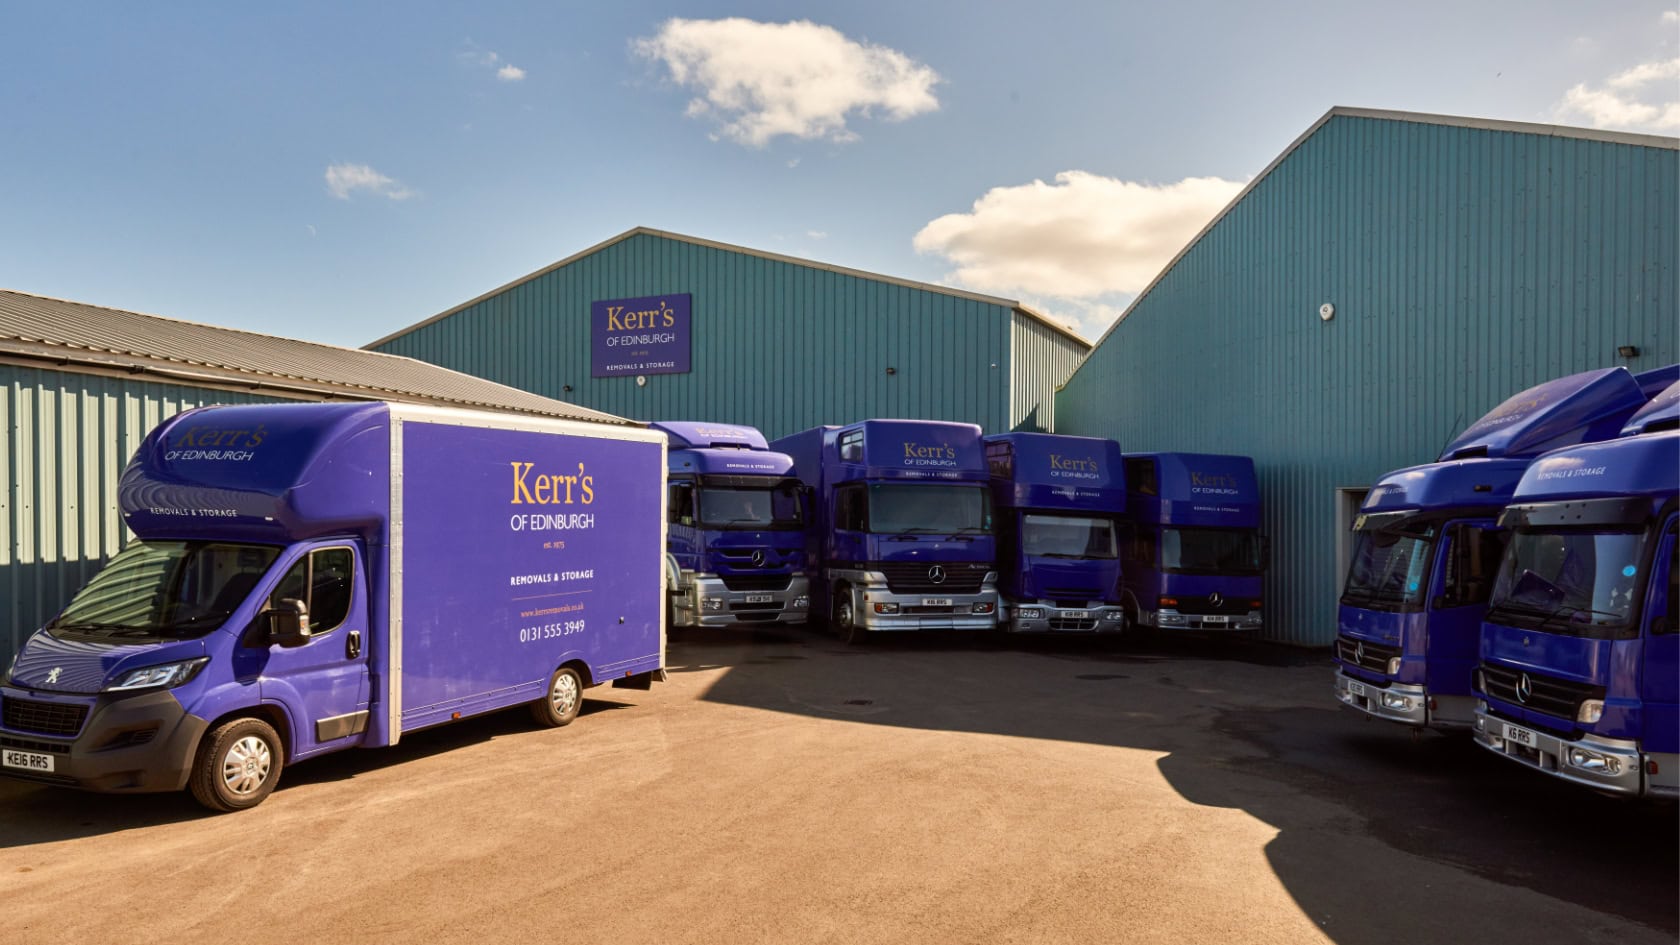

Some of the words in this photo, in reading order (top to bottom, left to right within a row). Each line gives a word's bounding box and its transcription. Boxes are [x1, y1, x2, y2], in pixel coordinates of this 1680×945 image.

[606, 301, 675, 331] Kerr's
[606, 336, 620, 347] OF
[621, 332, 675, 346] EDINBURGH
[606, 363, 638, 371] REMOVALS
[646, 361, 675, 369] STORAGE
[175, 423, 268, 447] Kerr's
[164, 450, 182, 460] OF
[181, 450, 254, 461] EDINBURGH
[904, 442, 956, 458] Kerr's
[1050, 454, 1098, 471] Kerr's
[1061, 471, 1100, 479] EDINBURGH
[1537, 470, 1567, 481] REMOVALS
[1573, 466, 1606, 477] STORAGE
[510, 461, 594, 505] Kerr's
[1202, 487, 1239, 495] EDINBURGH
[149, 507, 189, 516] REMOVALS
[199, 509, 238, 517] STORAGE
[510, 514, 528, 531] OF
[530, 513, 594, 531] EDINBURGH
[510, 573, 552, 586] REMOVALS
[553, 572, 559, 582] &
[561, 569, 594, 581] STORAGE
[520, 626, 541, 643] 0131
[544, 622, 561, 639] 555
[563, 619, 585, 636] 3949
[1508, 726, 1517, 740] K6
[1518, 728, 1530, 744] RRS
[7, 751, 28, 767] KE16
[30, 754, 48, 769] RRS
